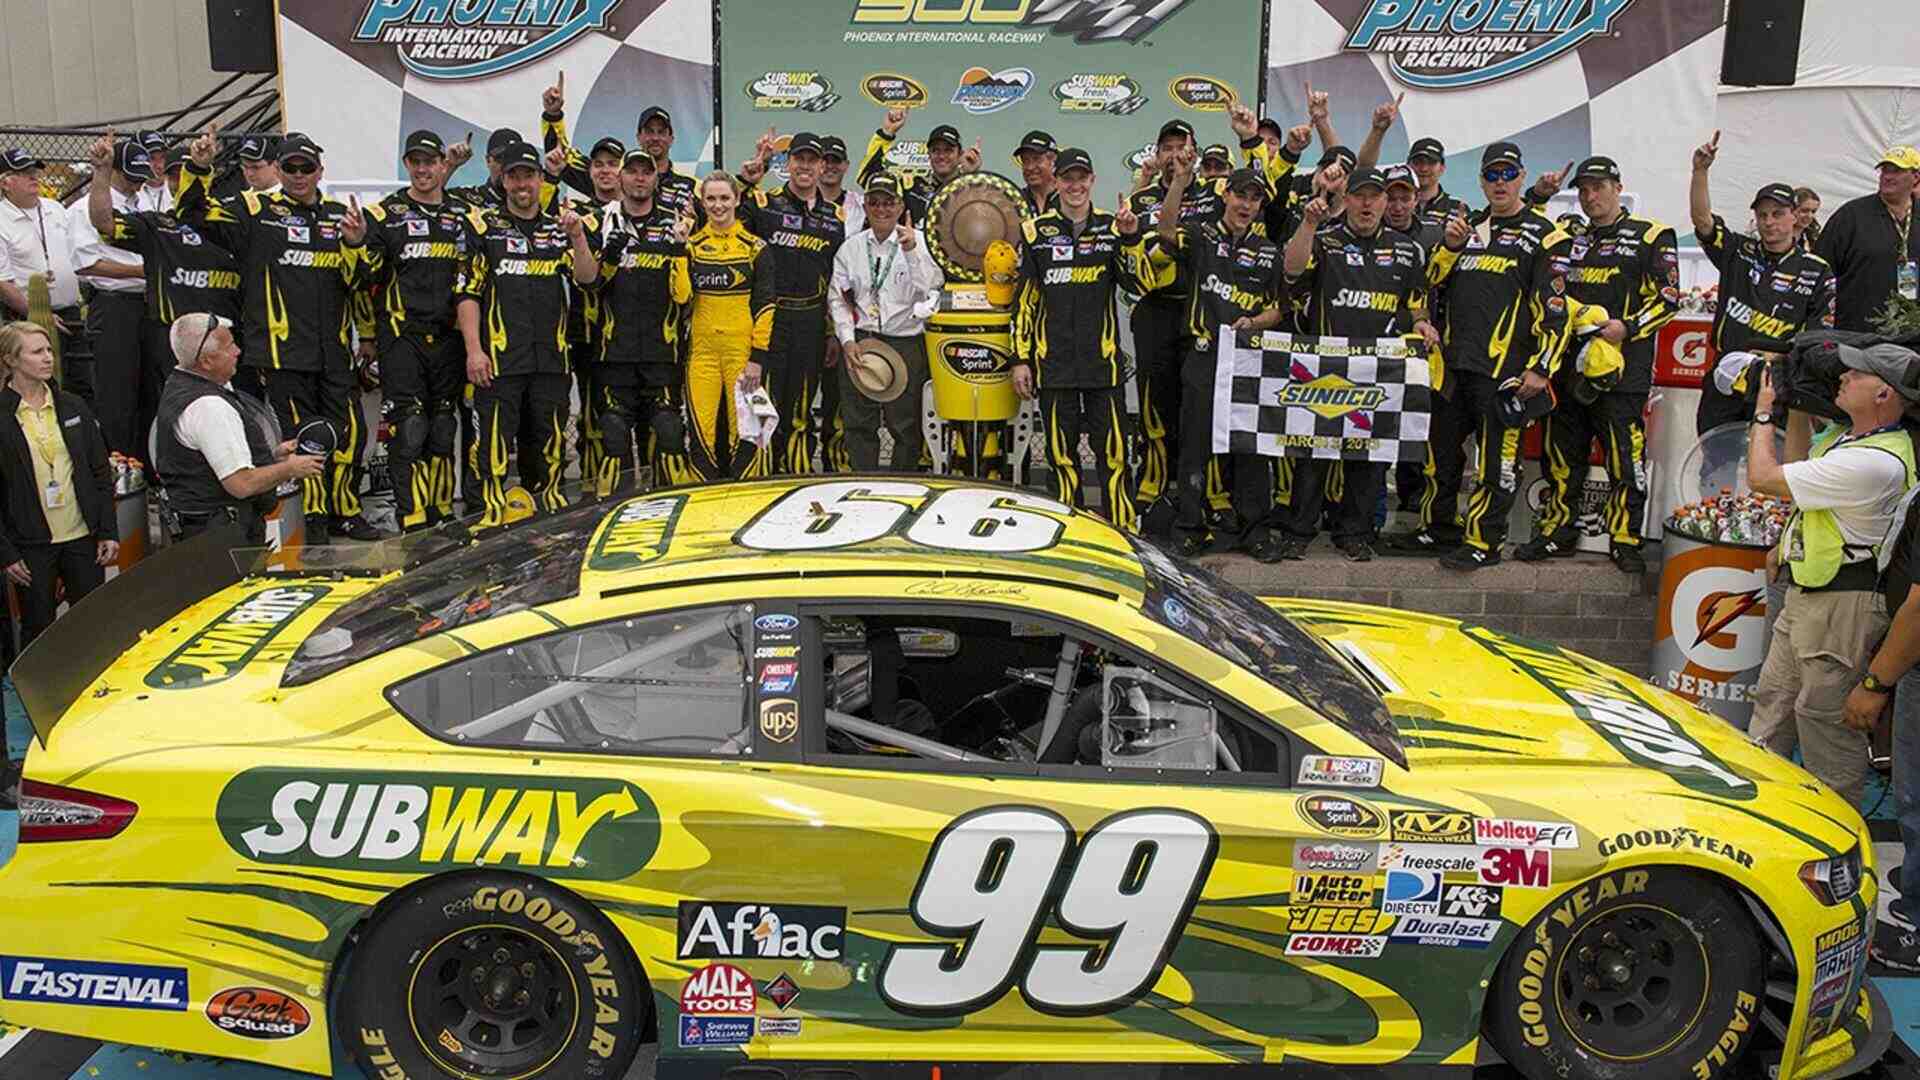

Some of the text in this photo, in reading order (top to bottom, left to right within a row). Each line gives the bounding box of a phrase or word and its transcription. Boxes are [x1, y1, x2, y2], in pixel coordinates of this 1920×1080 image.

[1348, 0, 1636, 47] PHOENIX
[384, 27, 529, 44] INTERNATIONAL
[843, 32, 1045, 43] PHOENIX INTERNATIONAL RACEWAY
[1375, 36, 1528, 52] INTERNATIONAL
[410, 44, 498, 59] RACEWAY
[1400, 52, 1496, 68] RACEWAY
[761, 72, 818, 86] SUBWAY
[1067, 74, 1126, 87] SUBWAY
[768, 230, 830, 253] SUBWAY
[495, 258, 562, 276] SUBWAY
[618, 253, 672, 269] UBWAY
[1458, 254, 1517, 274] SUBWAY
[693, 272, 729, 290] Sprint
[1043, 265, 1106, 285] SUBWAY
[1201, 273, 1264, 312] SUBWAY
[1726, 296, 1796, 340] SUBWAY
[961, 358, 993, 371] Sprint
[1281, 386, 1381, 406] SUNOCO
[202, 587, 315, 682] SUBWAY
[754, 646, 801, 658] SUBWAY
[763, 711, 796, 736] ups
[241, 780, 640, 868] SUBWAY
[1326, 812, 1358, 824] Sprint
[1477, 819, 1536, 845] Holley
[1598, 827, 1755, 869] GOODYEAR
[1402, 855, 1476, 871] freescale
[1481, 848, 1549, 887] 3M
[1316, 875, 1363, 889] Auto
[1310, 889, 1372, 902] Meter
[879, 806, 1213, 1012] 99
[1384, 901, 1435, 914] DIRECTV
[1288, 906, 1381, 935] JEGS
[1402, 916, 1491, 938] Duralast
[680, 905, 842, 959] Aflac
[1818, 919, 1860, 951] MOOG
[1290, 935, 1363, 951] COMP
[1518, 870, 1651, 1049] GOODYEAR
[472, 886, 621, 1059] GOODYEAR
[684, 965, 753, 999] MAC
[10, 961, 180, 1005] FASTENAL
[684, 999, 754, 1012] TOOLS
[218, 1016, 296, 1035] Squad
[705, 1030, 750, 1039] WILLIAMS
[706, 1022, 750, 1031] SHERWIN
[1692, 990, 1758, 1080] EAGLE
[360, 1027, 413, 1080] GLE
